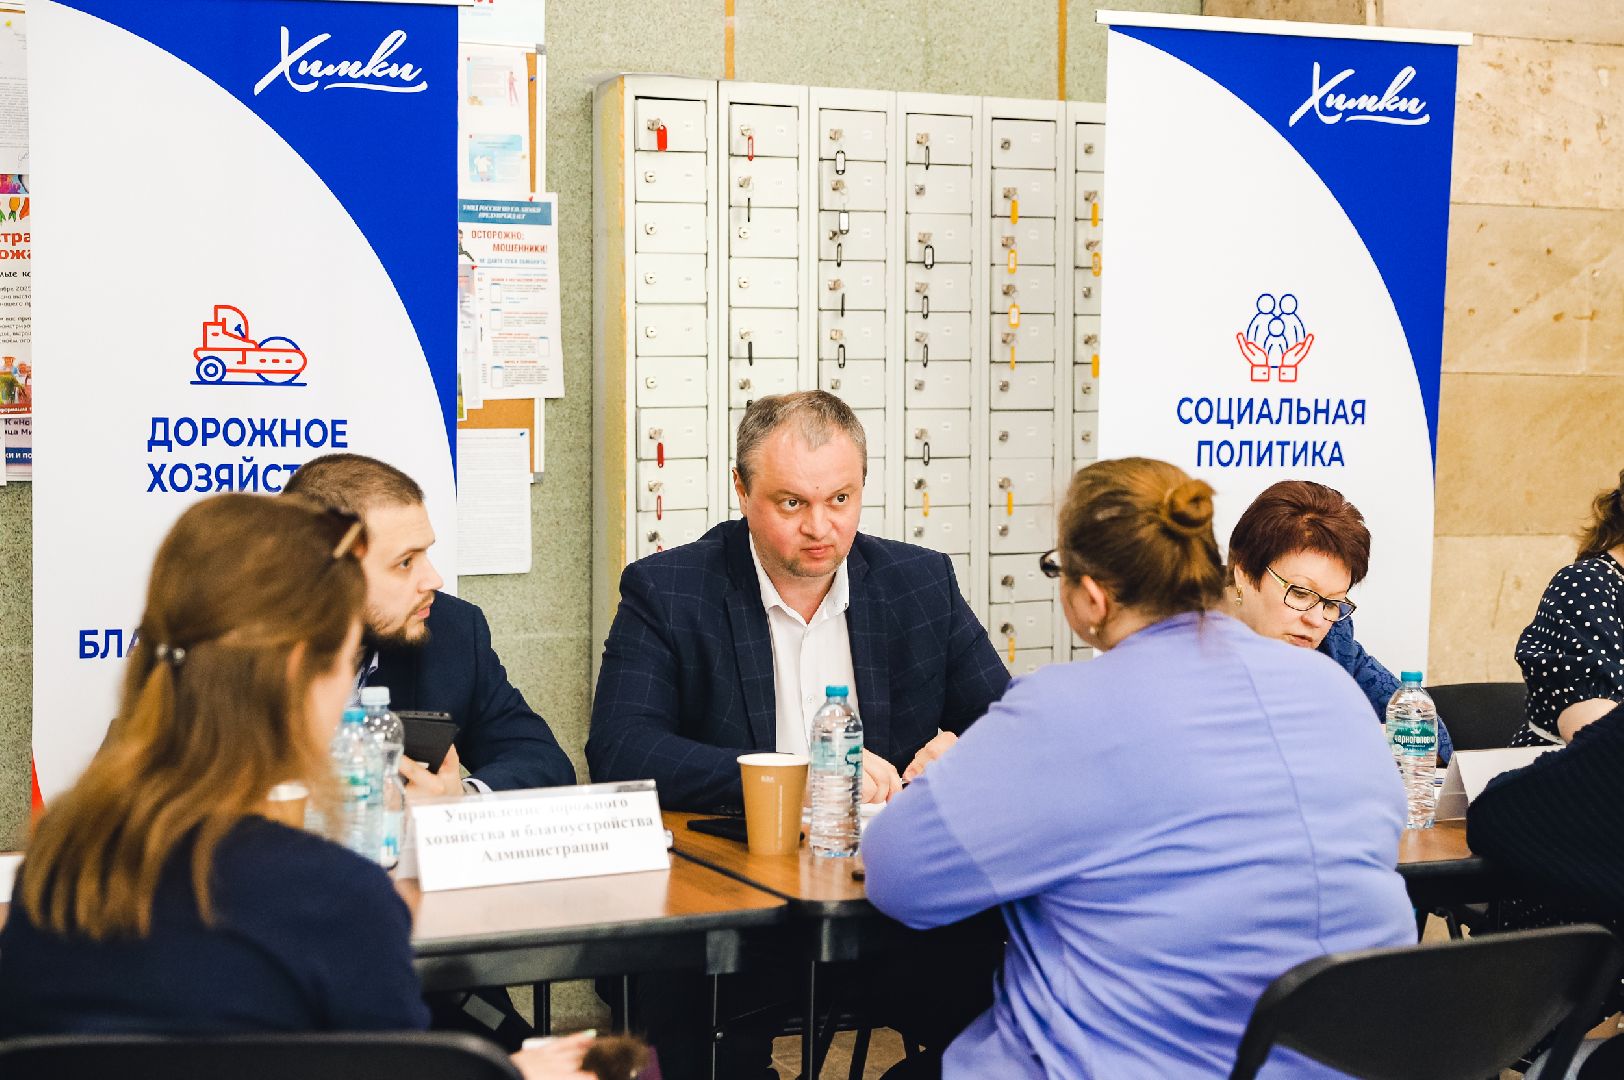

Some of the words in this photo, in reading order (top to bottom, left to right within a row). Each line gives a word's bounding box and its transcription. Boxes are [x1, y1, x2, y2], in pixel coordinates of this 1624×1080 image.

[254, 26, 428, 96] Химки
[1289, 61, 1430, 127] Химки
[0, 232, 30, 247] тра
[492, 243, 548, 253] МОШЕННИКИ!
[1176, 397, 1366, 429] СОЦИАЛЬНАЯ
[147, 417, 348, 452] ДОРОЖНОЕ
[1196, 440, 1345, 467] ПОЛИТИКА
[424, 828, 505, 847] хозяйства
[509, 828, 520, 839] и
[524, 816, 653, 839] благоустройства
[481, 840, 610, 863] Администрации
